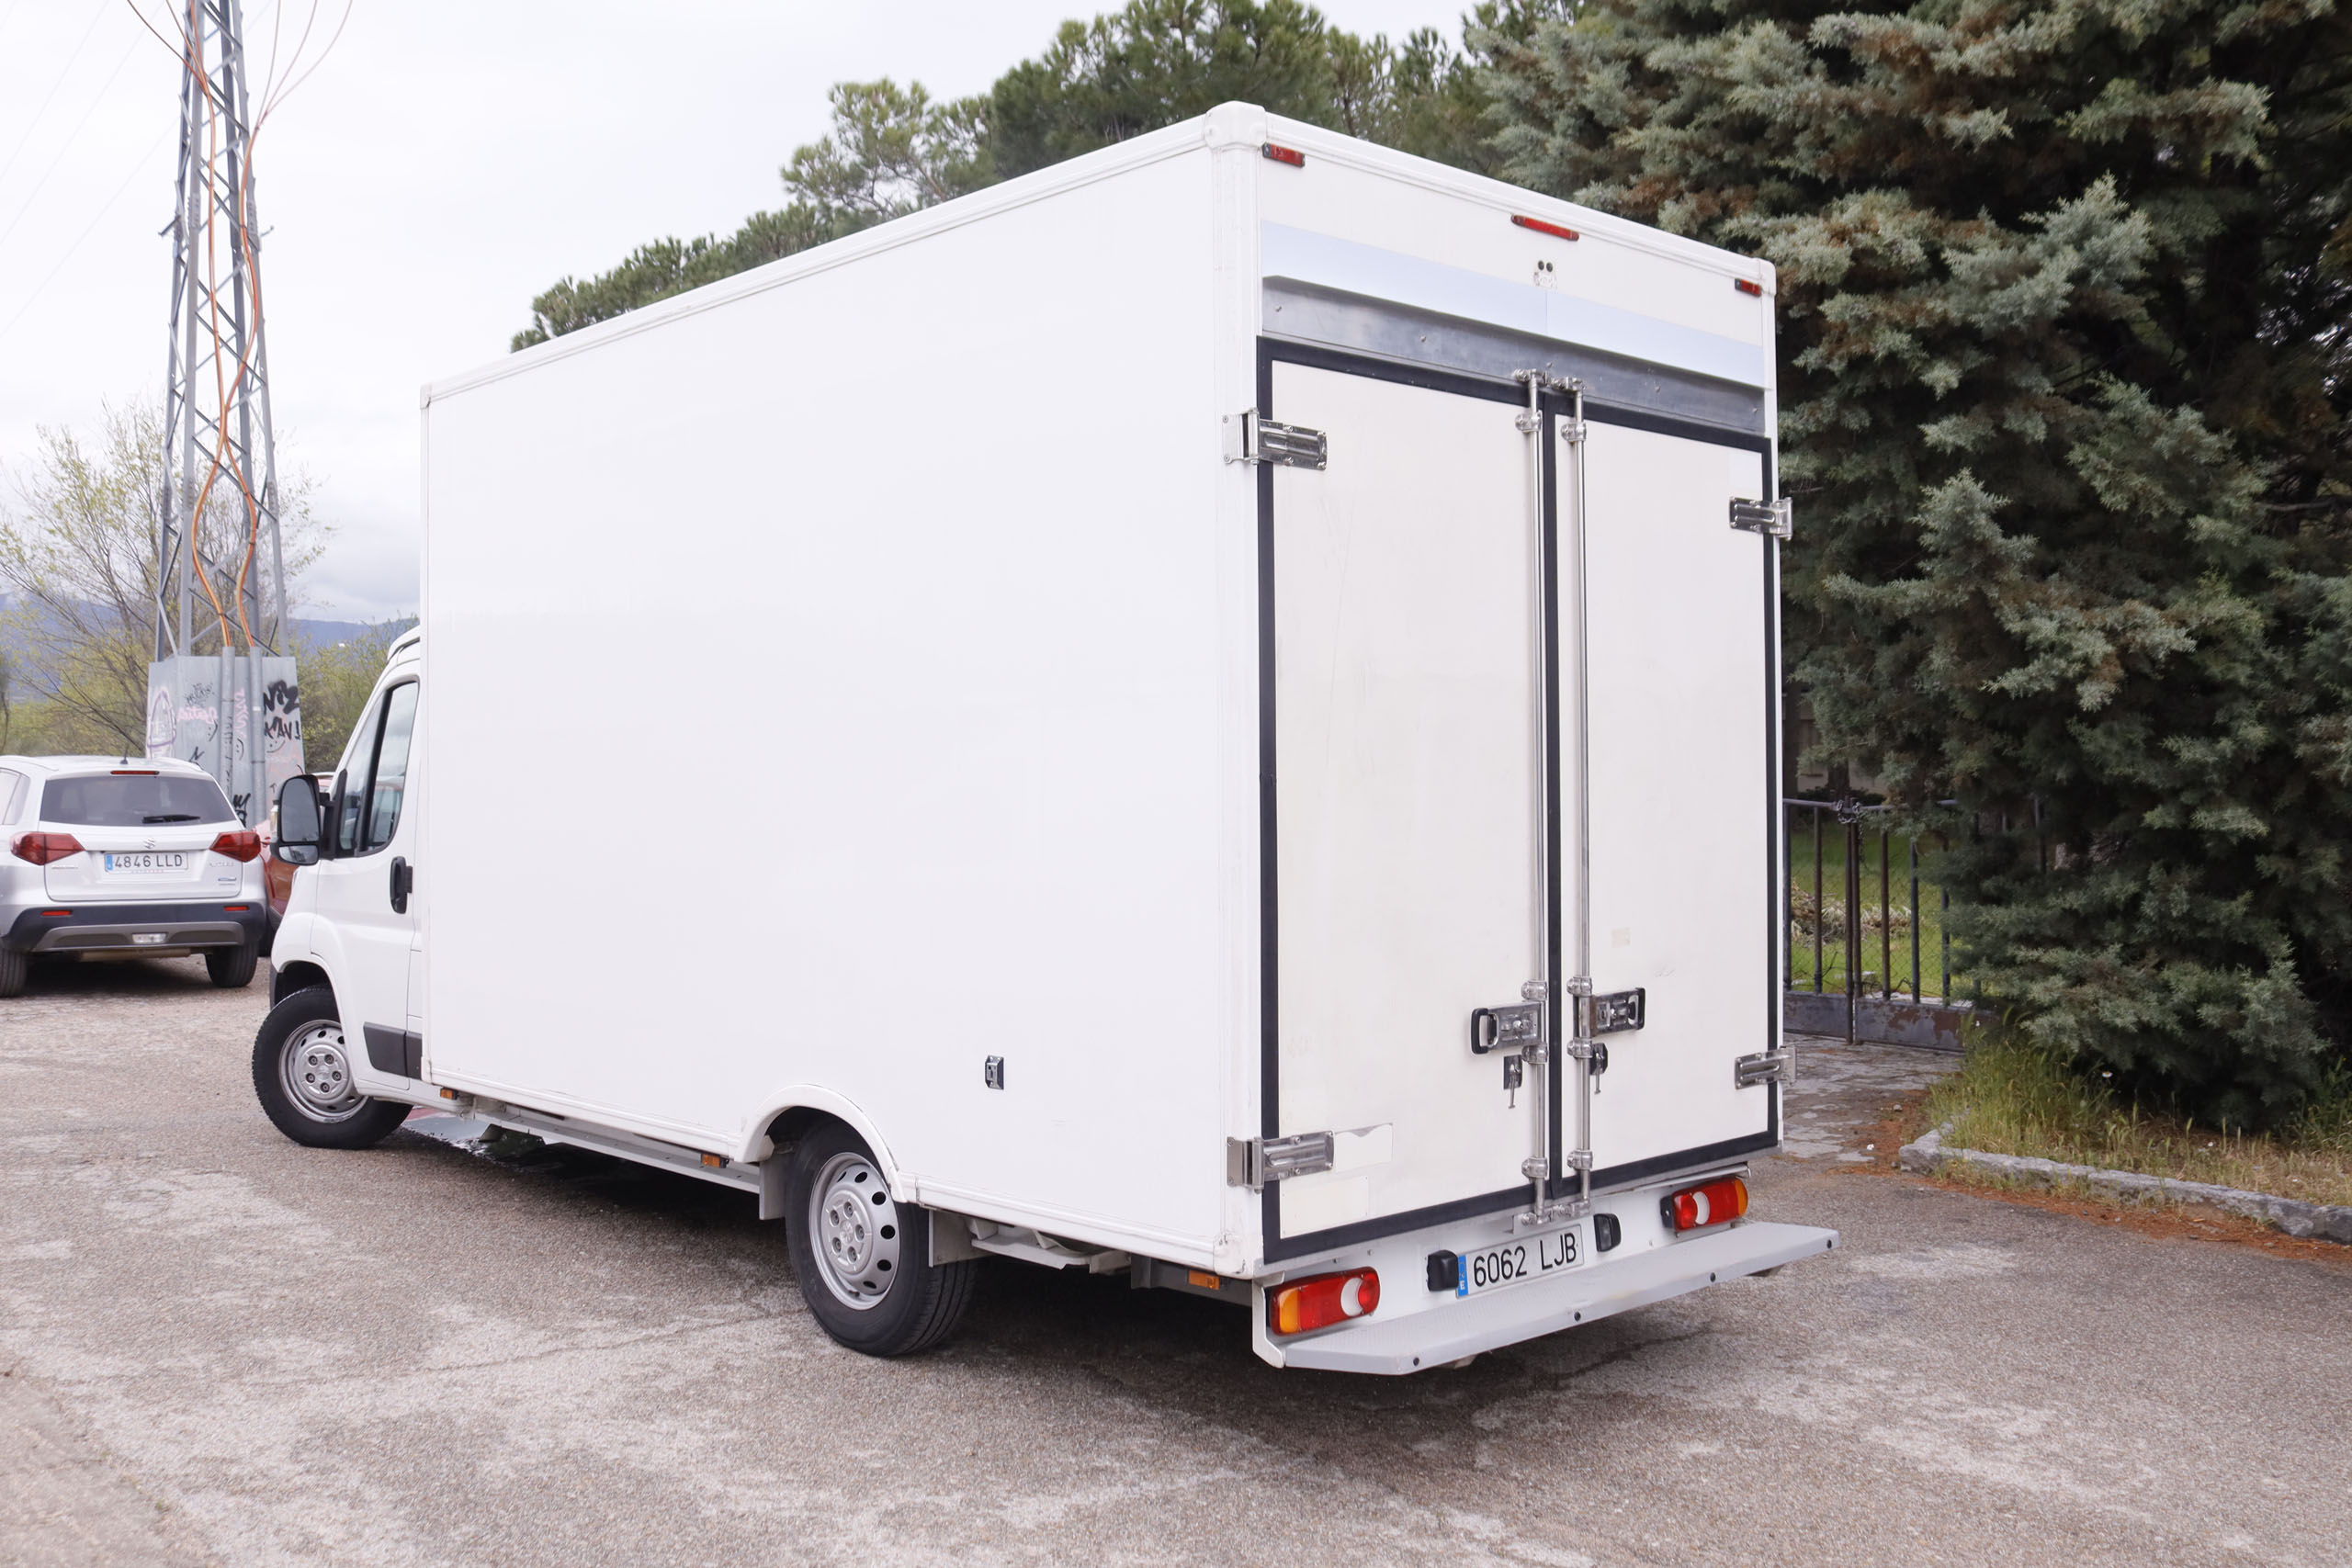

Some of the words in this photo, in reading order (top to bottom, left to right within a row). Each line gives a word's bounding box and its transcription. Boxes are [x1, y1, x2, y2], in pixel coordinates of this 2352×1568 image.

[115, 854, 151, 868] 4846
[156, 853, 183, 867] LLD
[1474, 1246, 1527, 1287] 6062
[1540, 1233, 1577, 1270] LJB
